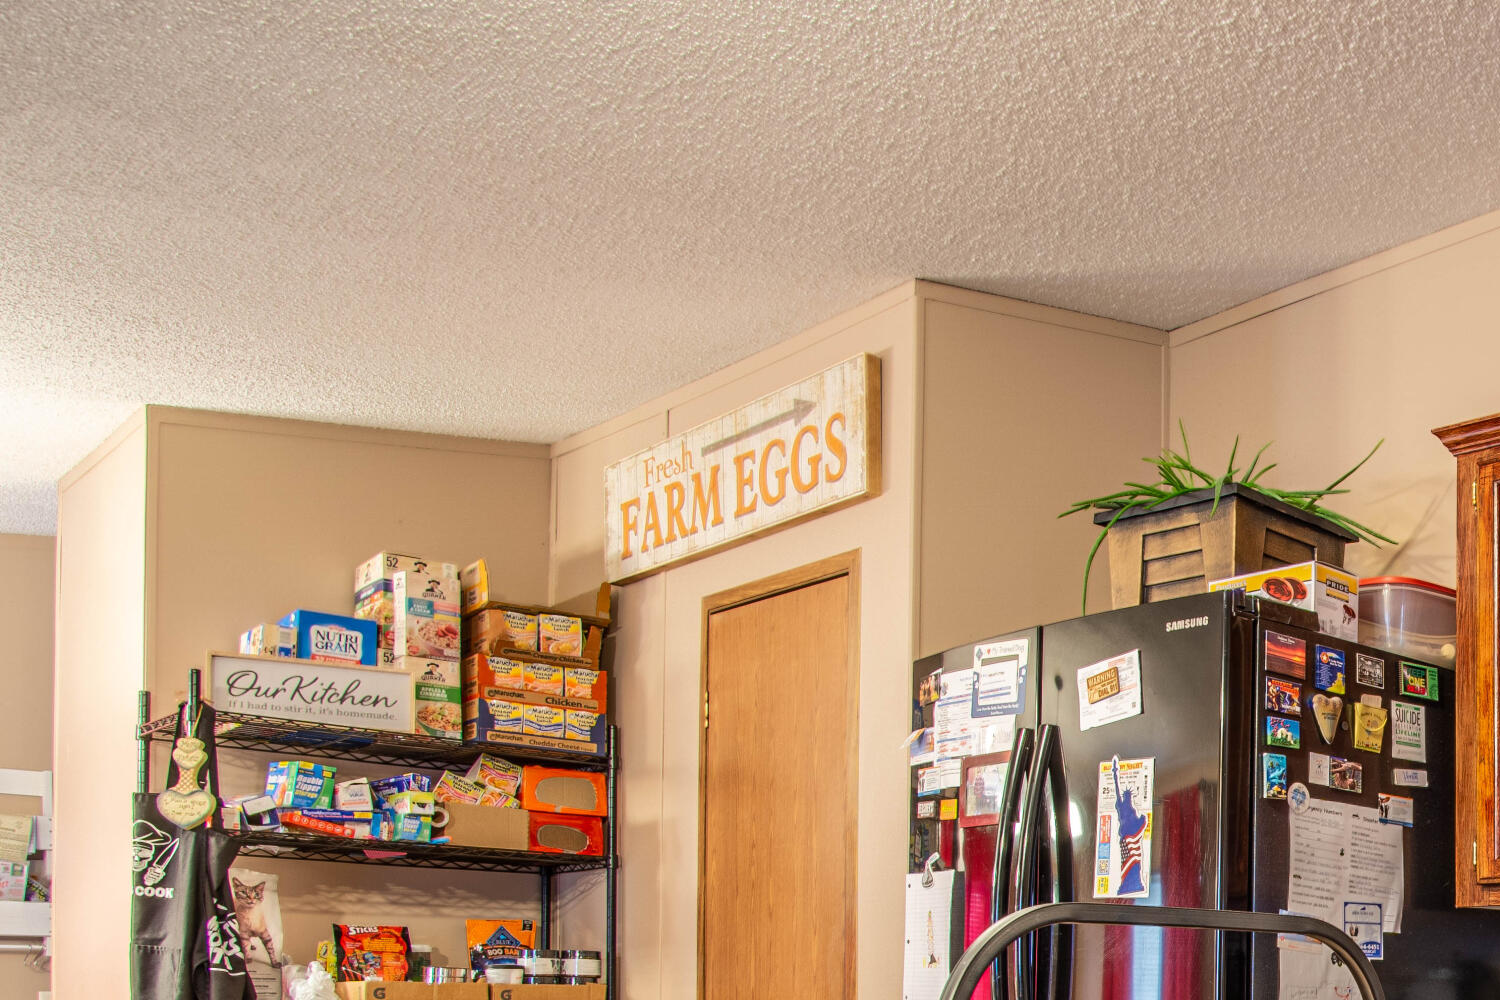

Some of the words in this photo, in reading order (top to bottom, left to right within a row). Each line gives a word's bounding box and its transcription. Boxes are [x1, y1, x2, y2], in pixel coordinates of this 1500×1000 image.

[642, 440, 694, 488] Fresh
[620, 464, 724, 560] FARM
[733, 412, 848, 517] EGGS
[386, 556, 399, 568] 52
[1326, 580, 1350, 592] PRIDE
[422, 592, 446, 600] QUAKER
[506, 614, 535, 623] Maruchan
[549, 616, 579, 625] Maruchan
[1165, 615, 1209, 632] SAMSUNG
[316, 630, 358, 642] NUTRI
[315, 641, 358, 655] GRAIN
[383, 652, 395, 664] 52
[489, 658, 520, 668] Maruchan
[532, 651, 557, 661] Creamy
[559, 656, 584, 665] Chicken
[531, 664, 561, 674] Maruchan
[574, 670, 599, 678] Marucha
[421, 674, 446, 683] QUAKER
[1087, 668, 1117, 688] WARNING
[227, 670, 286, 699] Our
[282, 674, 399, 709] Kitchen
[489, 701, 520, 711] Maruchan
[545, 696, 583, 708] Chicken
[229, 701, 237, 709] If
[247, 701, 267, 711] had
[271, 704, 282, 712] to
[284, 705, 303, 714] stir
[319, 707, 334, 716] it's
[336, 708, 398, 721] homemade.
[531, 708, 561, 717] Maruchan
[1395, 707, 1421, 726] SUICIDE
[574, 713, 599, 722] Marucha
[528, 739, 557, 748] Cheddar
[297, 774, 324, 786] Double
[295, 782, 322, 793] Zipper
[134, 886, 175, 899] COOK
[348, 925, 379, 935] STICKS
[373, 987, 386, 999] G
[500, 989, 512, 1000] G
